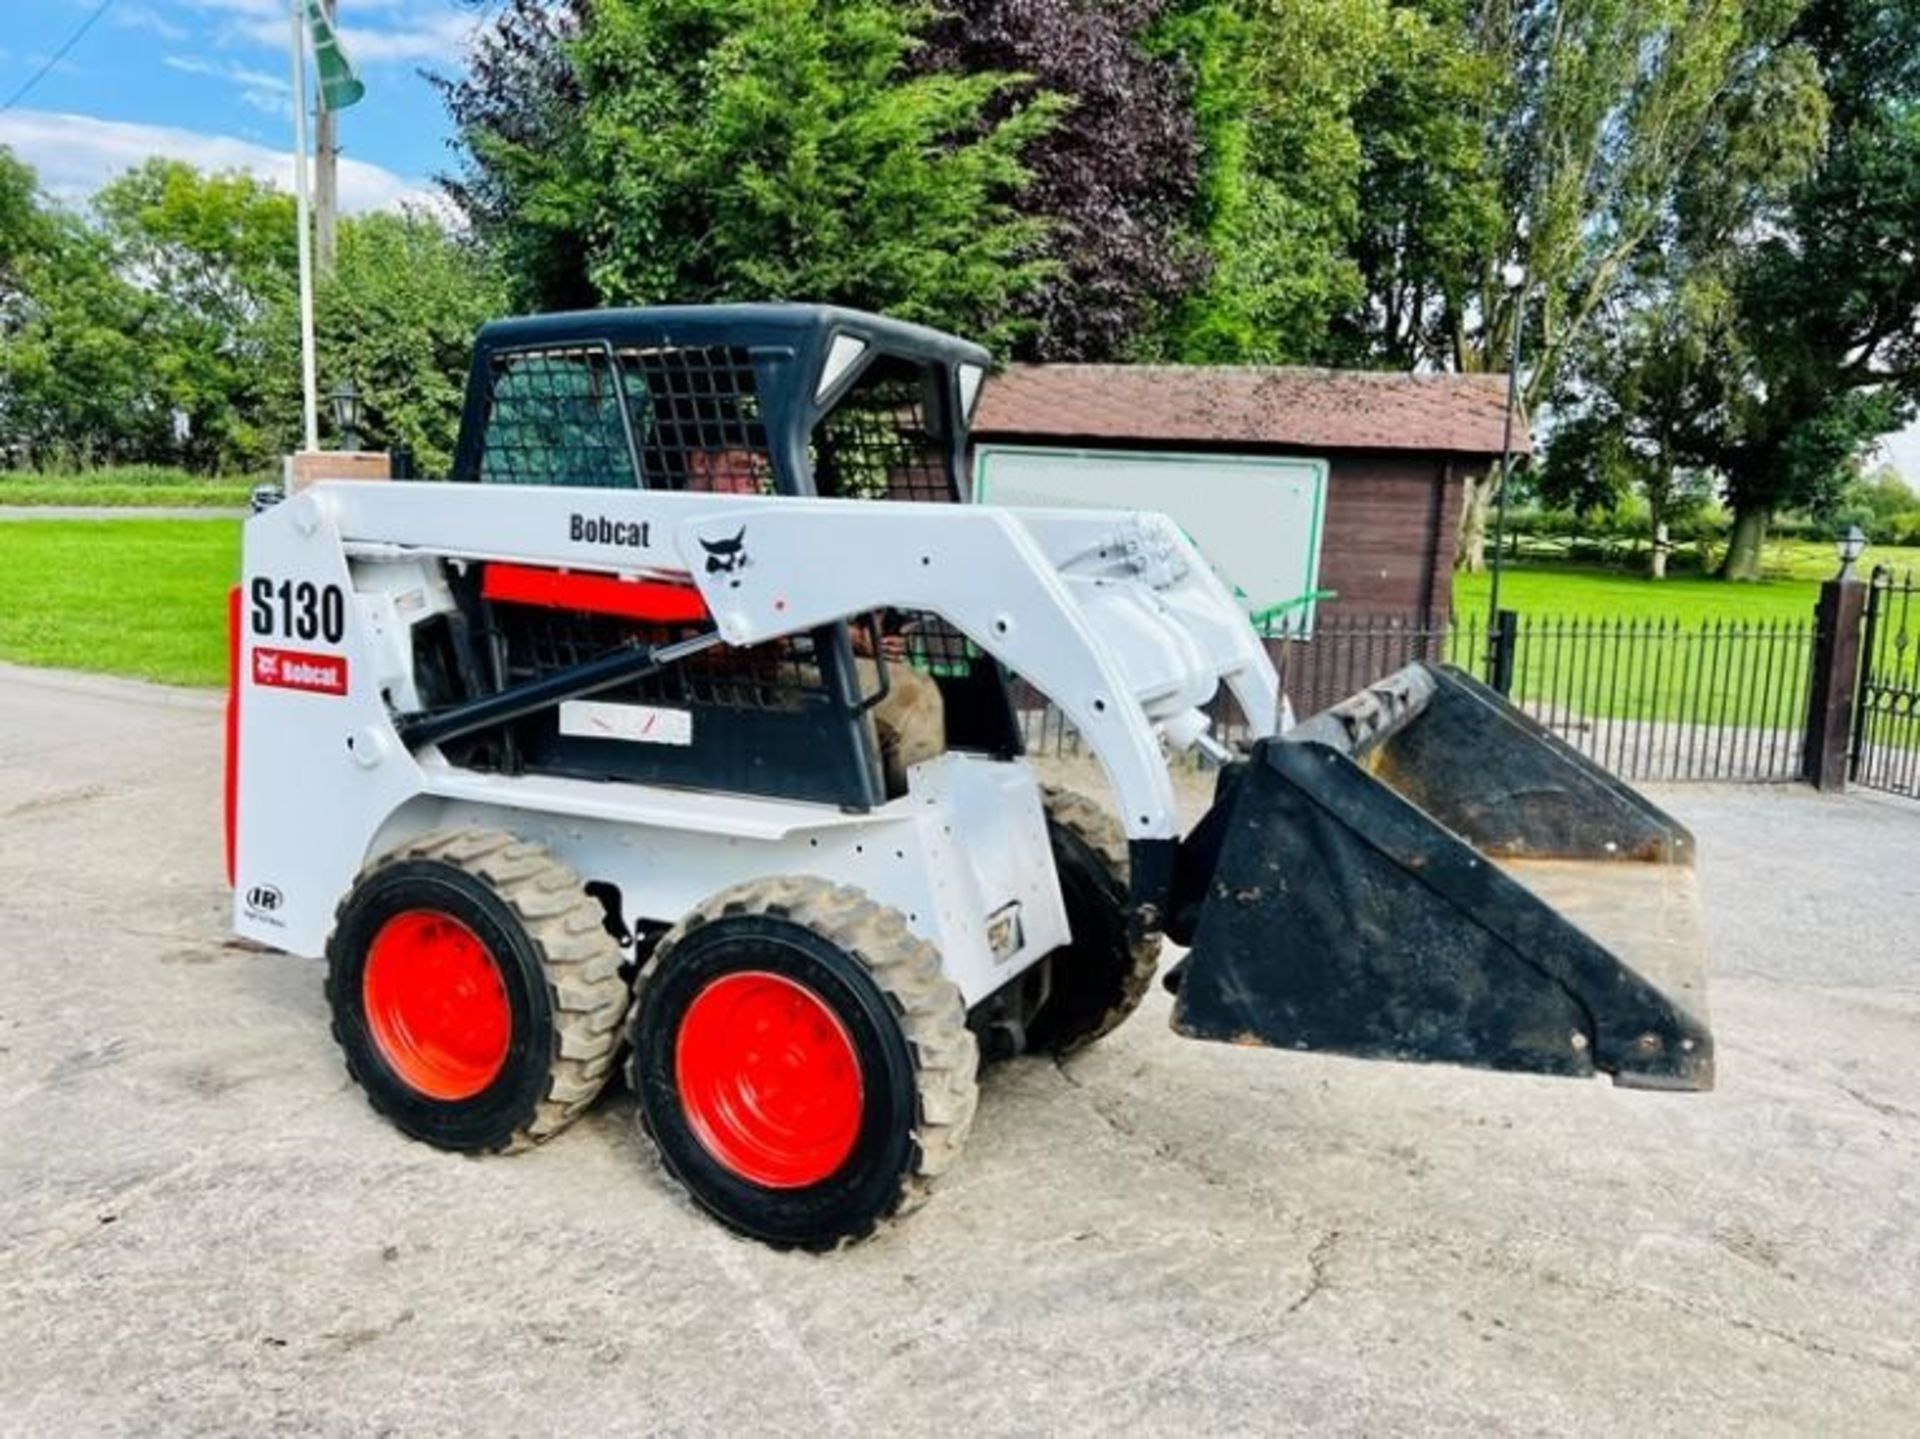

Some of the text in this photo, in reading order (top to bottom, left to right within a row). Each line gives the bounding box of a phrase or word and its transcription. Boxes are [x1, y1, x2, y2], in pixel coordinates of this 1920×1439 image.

[570, 513, 650, 548] Bobcat
[252, 576, 344, 644] S130
[281, 659, 338, 687] Bobcat
